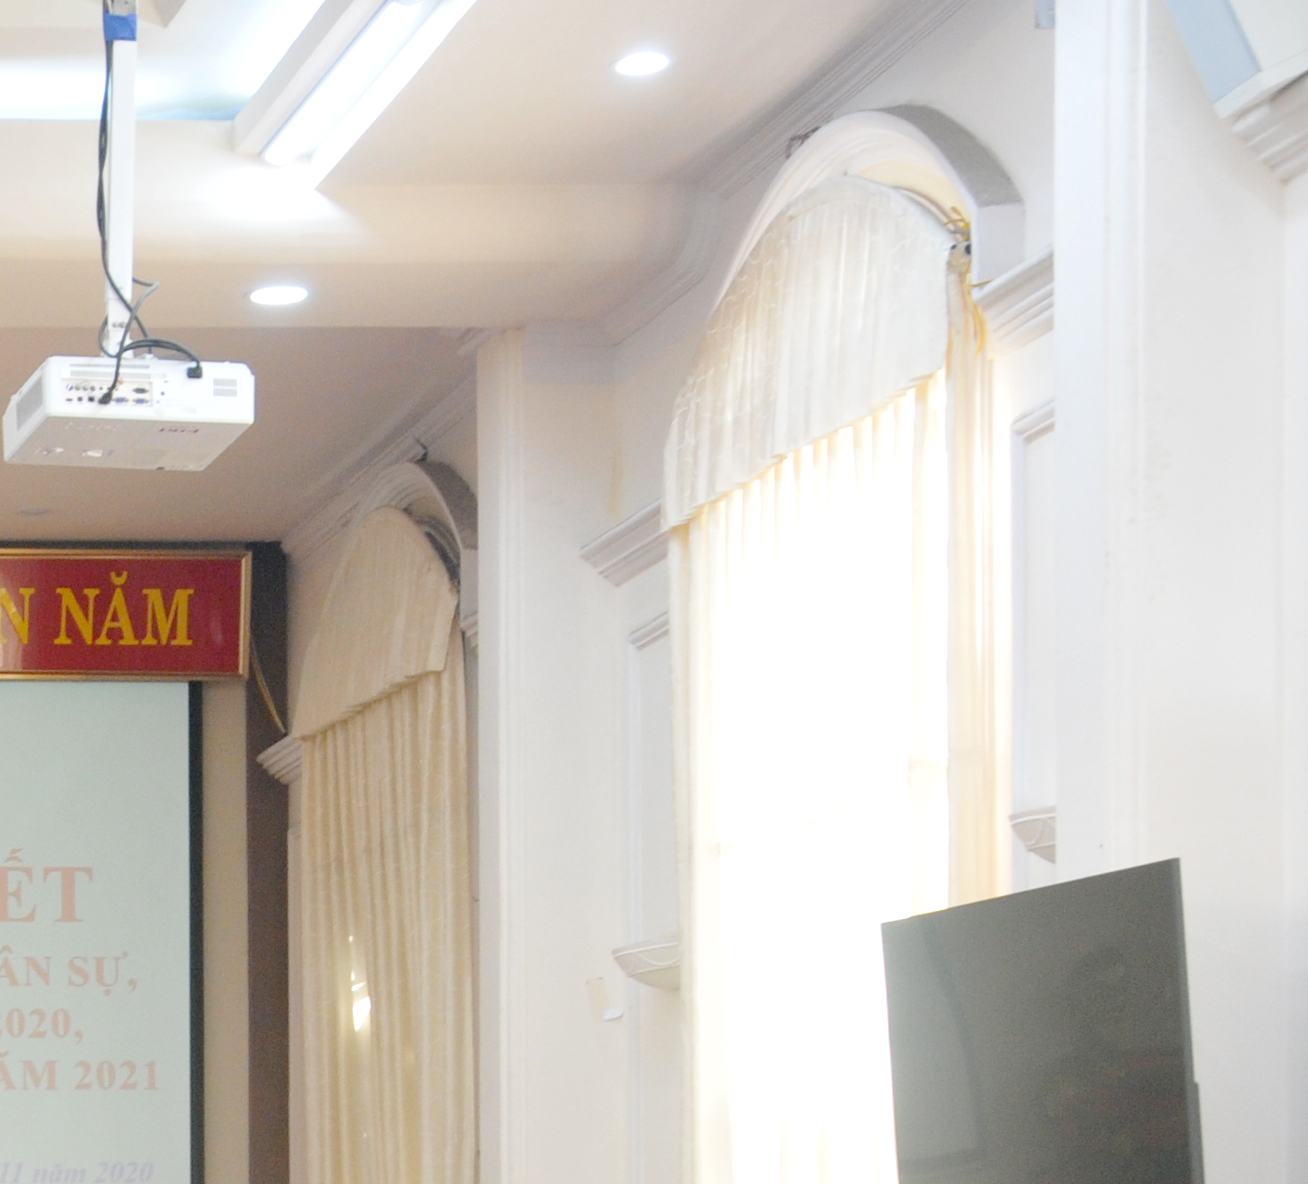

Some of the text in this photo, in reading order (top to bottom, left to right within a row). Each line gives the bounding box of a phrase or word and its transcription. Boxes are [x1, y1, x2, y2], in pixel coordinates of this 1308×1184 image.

[54, 571, 195, 647] NĂM
[68, 951, 138, 996] SỰ,
[73, 1060, 159, 1090] 2021
[31, 1163, 87, 1184] năm
[93, 1161, 155, 1184] 2020
